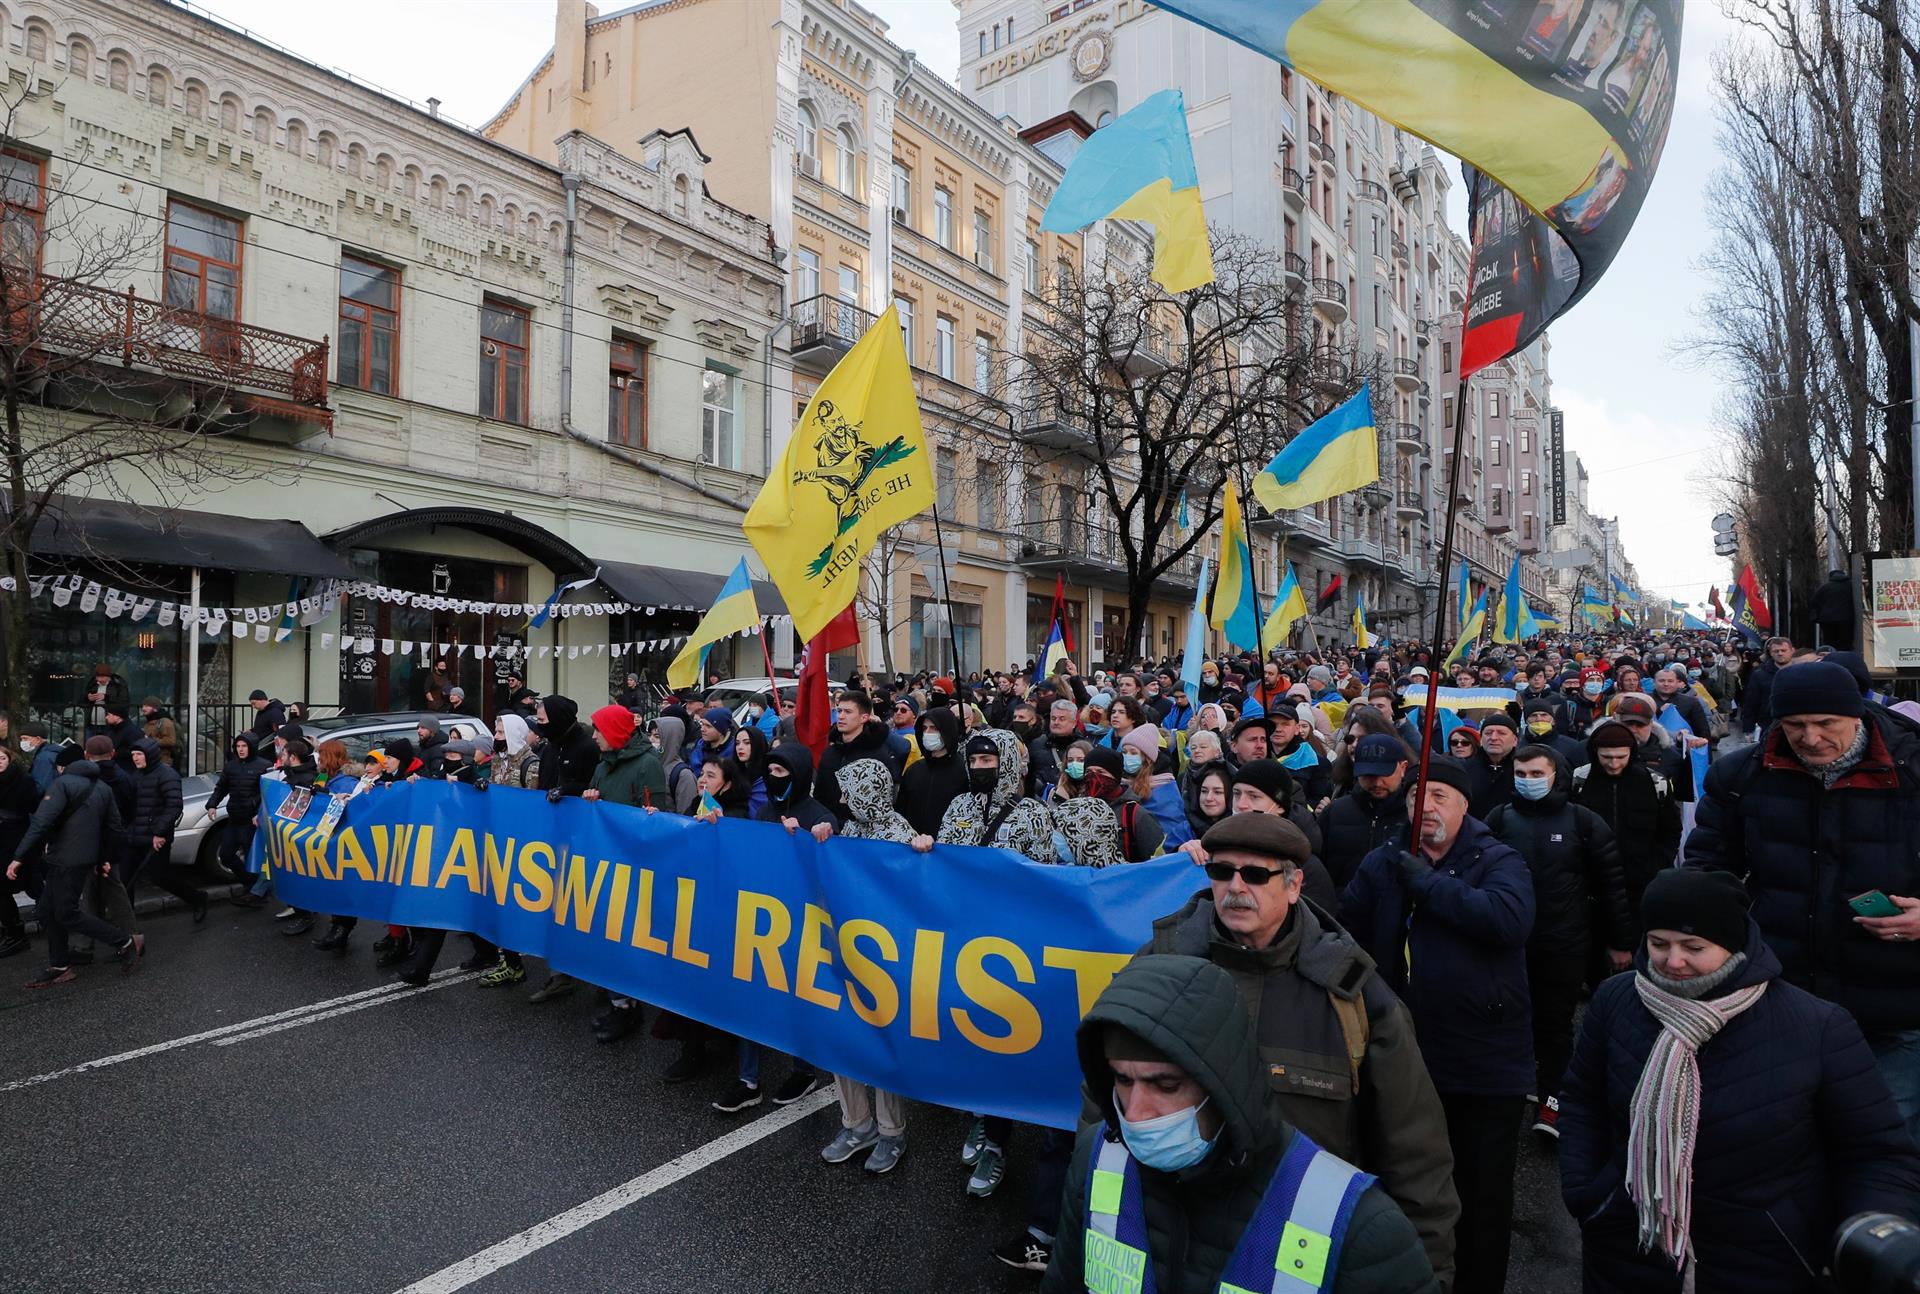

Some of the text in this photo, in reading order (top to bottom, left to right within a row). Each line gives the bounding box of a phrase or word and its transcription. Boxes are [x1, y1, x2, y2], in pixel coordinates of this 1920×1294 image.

[268, 818, 1134, 1055] UKRAINIANS WILL RESIST
[1300, 1076, 1334, 1091] Timberland
[1087, 1233, 1142, 1279] ПОЛІЦІЯ
